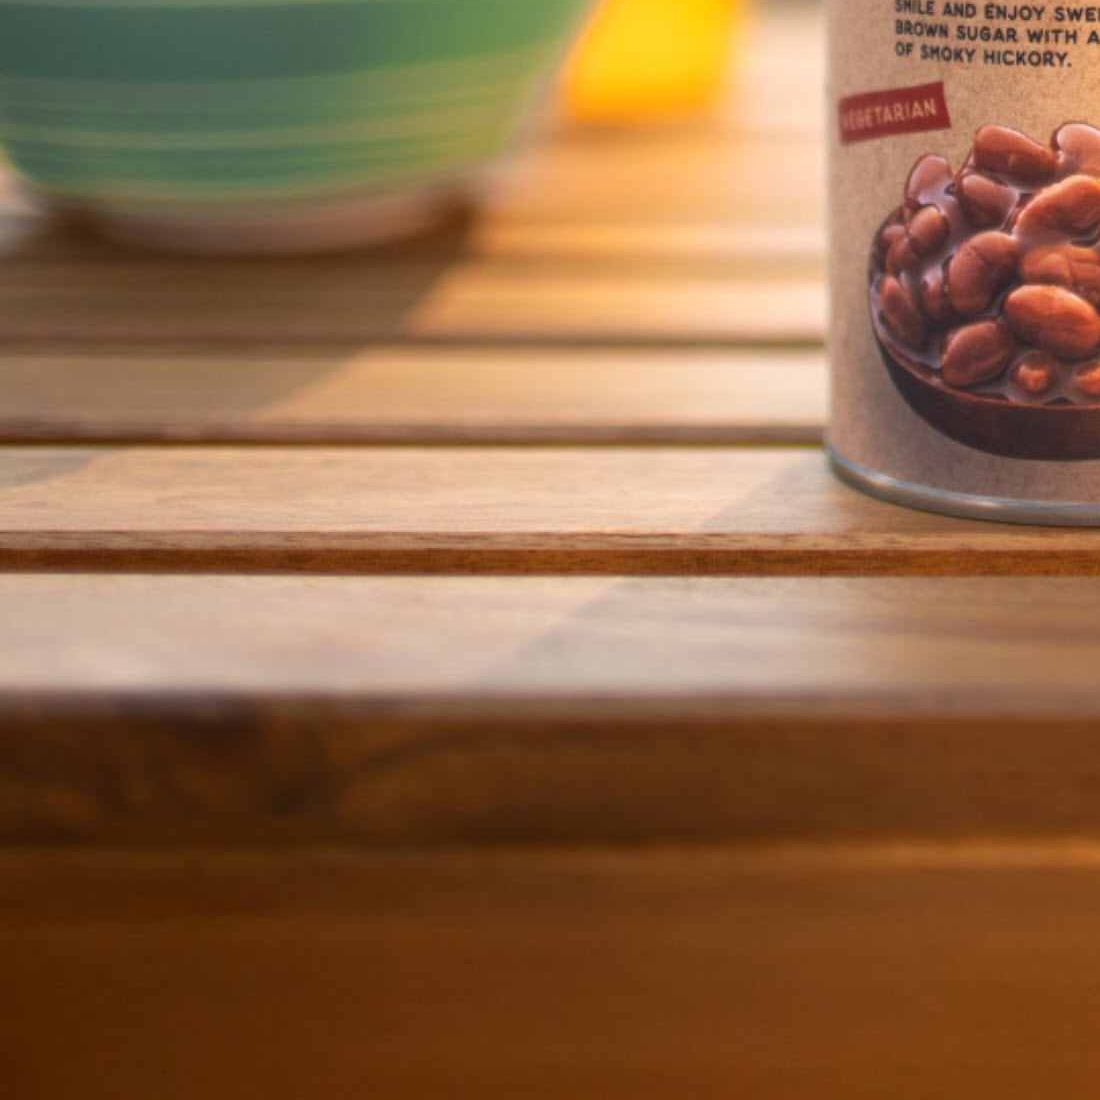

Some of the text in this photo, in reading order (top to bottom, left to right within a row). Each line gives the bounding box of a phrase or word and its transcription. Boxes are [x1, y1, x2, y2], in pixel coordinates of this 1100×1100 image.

[942, 2, 976, 18] AND
[984, 3, 1045, 21] ENJOY
[895, 19, 948, 38] BROWN
[957, 24, 1018, 43] SUGAR
[1026, 28, 1077, 45] WITH
[1087, 29, 1100, 45] A
[894, 42, 1072, 68] OF SMOKY HICKORY.
